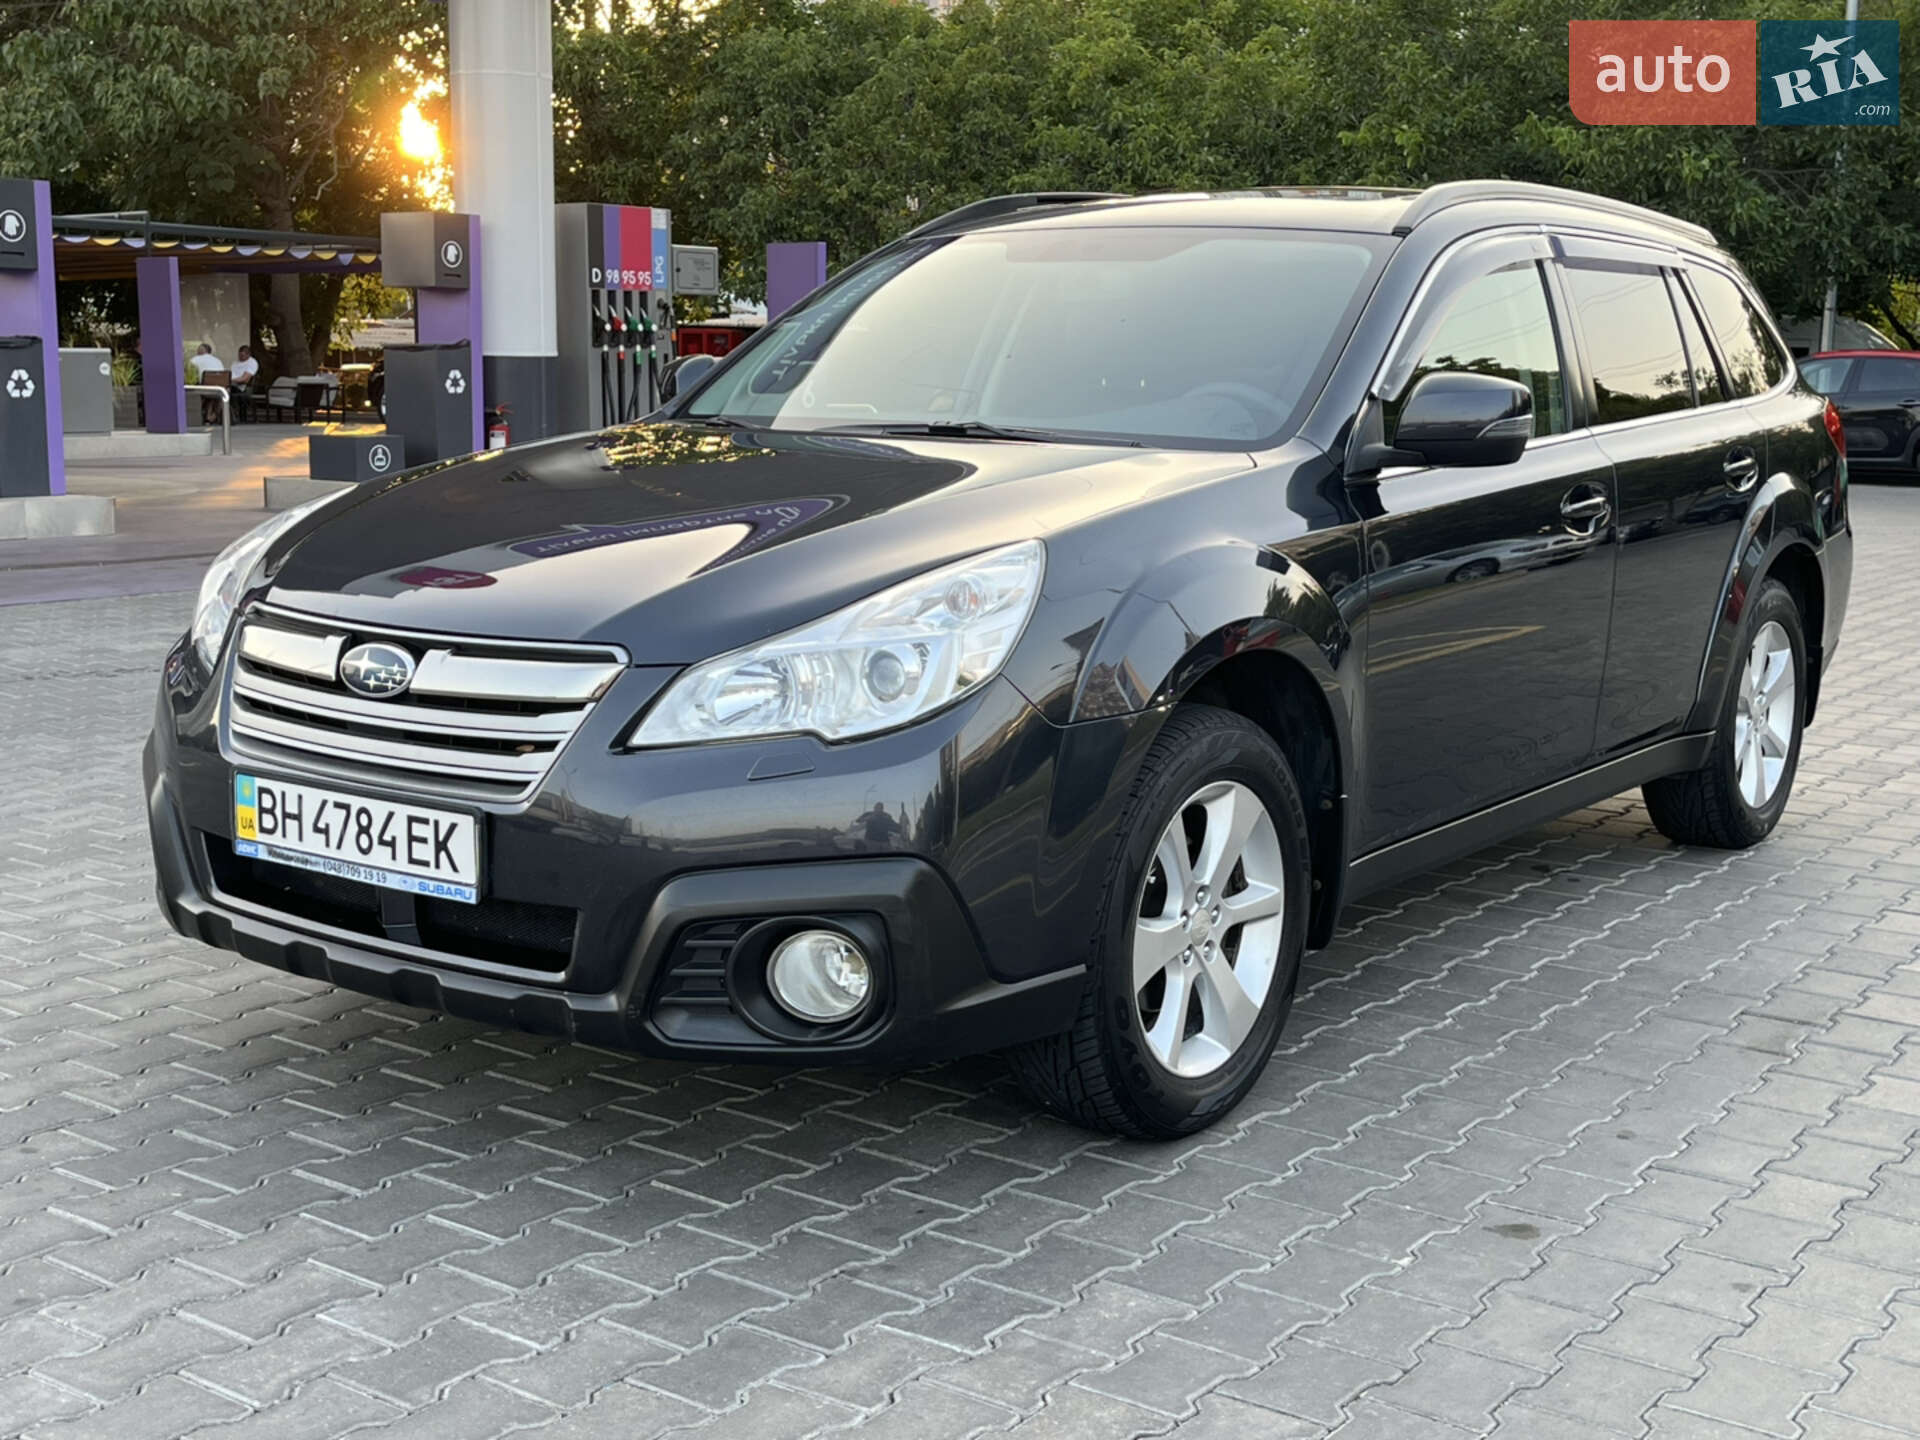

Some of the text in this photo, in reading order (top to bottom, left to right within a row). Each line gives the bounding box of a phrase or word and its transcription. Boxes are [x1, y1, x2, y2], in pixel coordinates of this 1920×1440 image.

[591, 267, 652, 286] D 98 95 95
[654, 255, 665, 283] LPG
[240, 816, 255, 831] UA
[257, 785, 460, 874] BH 4784 EK
[417, 880, 473, 901] SUBARU
